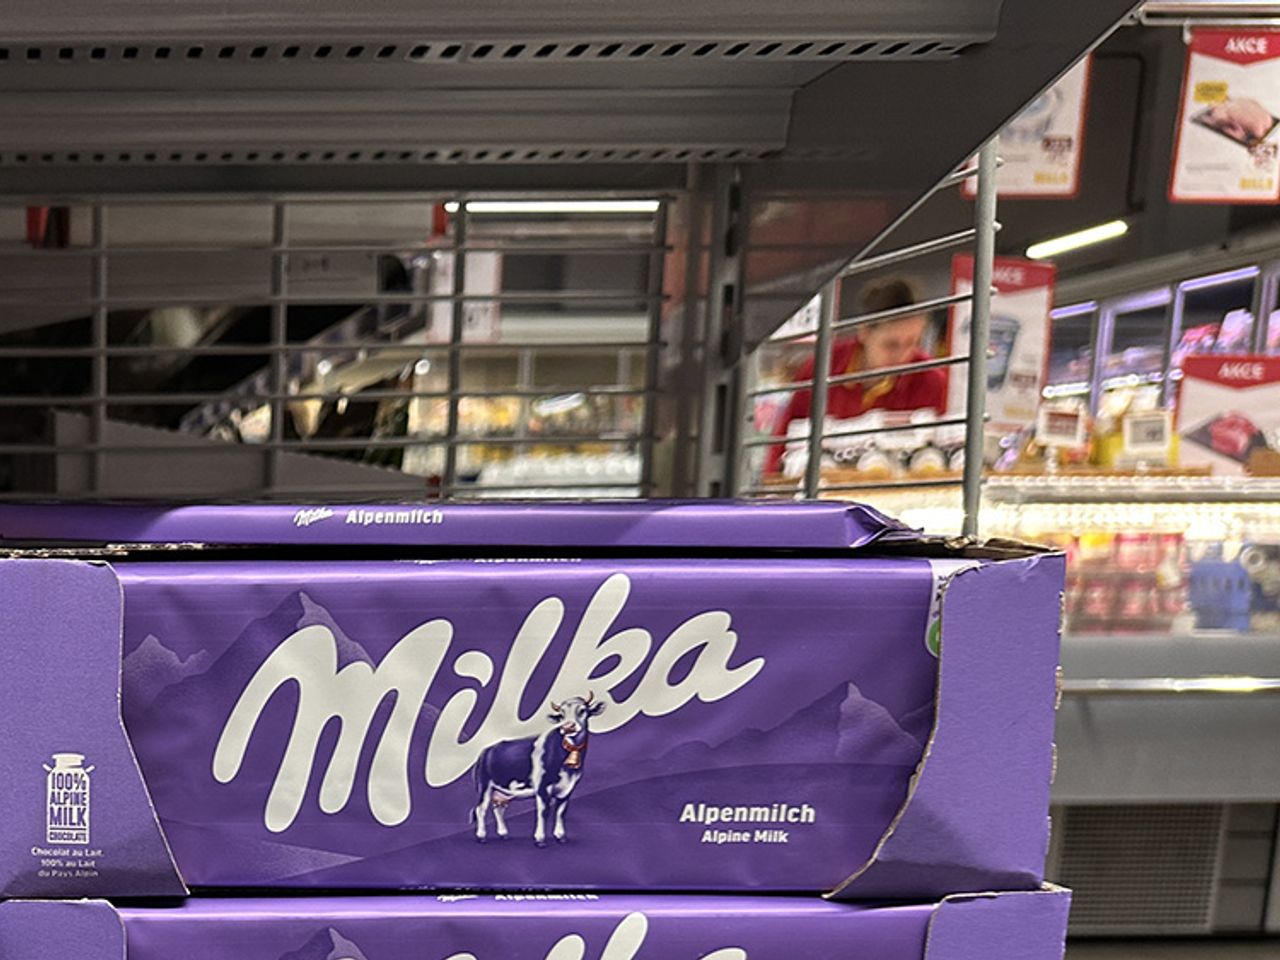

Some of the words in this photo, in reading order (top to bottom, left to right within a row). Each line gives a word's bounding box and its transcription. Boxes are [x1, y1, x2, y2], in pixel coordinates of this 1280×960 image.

[1225, 36, 1268, 54] AKCE
[1218, 361, 1265, 380] AKCE
[345, 509, 444, 526] Alpenmilch
[212, 572, 766, 833] Milka
[51, 772, 87, 790] 100%
[49, 791, 87, 806] ALPINE
[49, 807, 87, 827] MILK
[679, 803, 816, 826] Alpenmilch
[701, 829, 752, 845] Alpine
[753, 829, 790, 844] Milk
